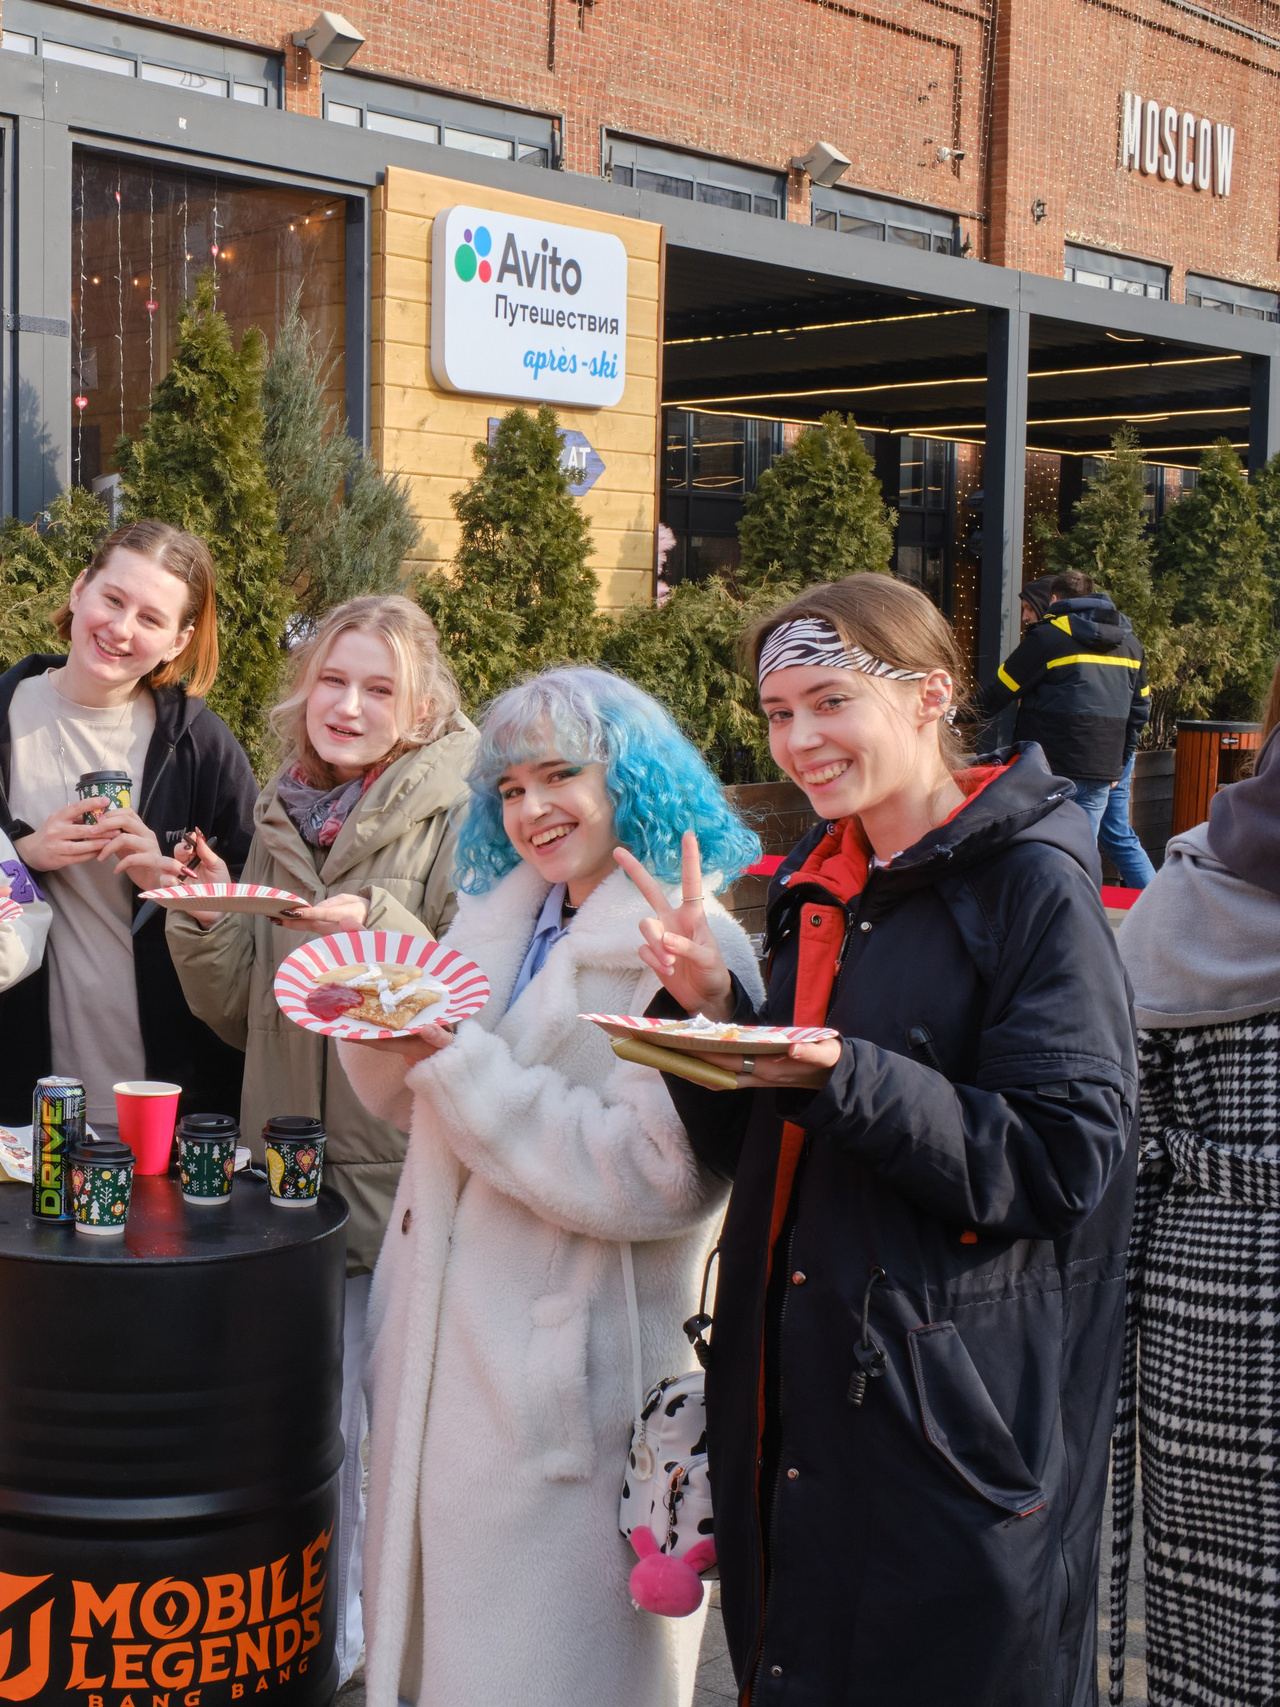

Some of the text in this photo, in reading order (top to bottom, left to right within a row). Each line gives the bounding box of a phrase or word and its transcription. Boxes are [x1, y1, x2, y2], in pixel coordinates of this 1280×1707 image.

[1122, 90, 1235, 196] MOSCOW
[495, 293, 619, 336] Путешествия
[496, 232, 582, 296] Avito
[40, 1095, 65, 1215] DRIVE
[64, 1570, 328, 1691] LEGENDS
[70, 1516, 335, 1640] MOBILE
[88, 1658, 309, 1707] BANG BANG
